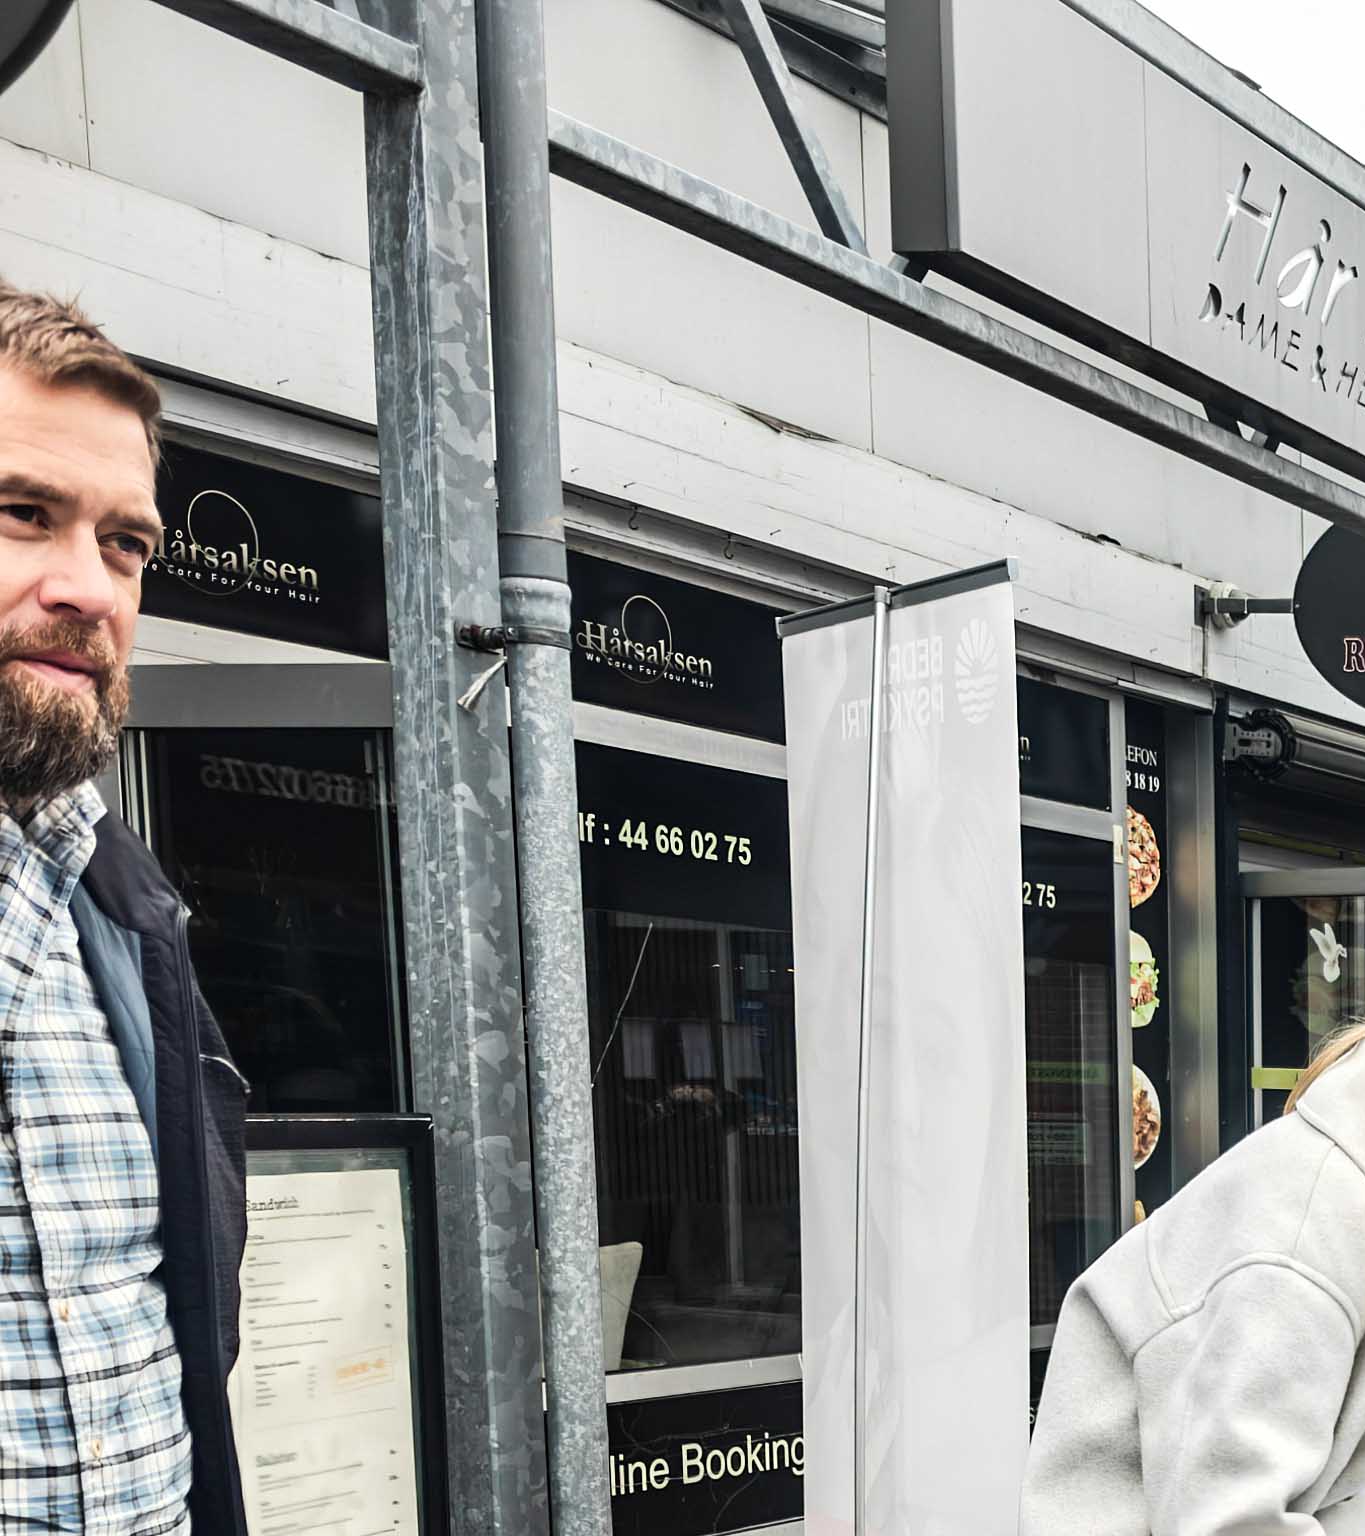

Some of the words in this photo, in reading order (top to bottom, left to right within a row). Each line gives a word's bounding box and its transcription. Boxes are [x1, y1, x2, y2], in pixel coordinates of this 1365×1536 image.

[1215, 162, 1359, 327] Hår
[1199, 283, 1300, 372] DAME
[1311, 345, 1327, 392] &
[167, 564, 201, 580] Care
[211, 573, 236, 586] For
[289, 589, 321, 604] Hair
[579, 619, 713, 677] Hårsaksen
[1127, 744, 1158, 766] EFON
[1134, 772, 1146, 790] 18
[1148, 775, 1160, 793] 19
[578, 812, 595, 842] lf
[618, 819, 649, 850] 44
[655, 824, 684, 857] 66
[690, 829, 719, 862] 02
[724, 835, 752, 865] 75
[1022, 881, 1032, 906] 2
[1036, 882, 1057, 909] 75
[609, 1453, 670, 1497] line
[681, 1431, 805, 1485] Booking
